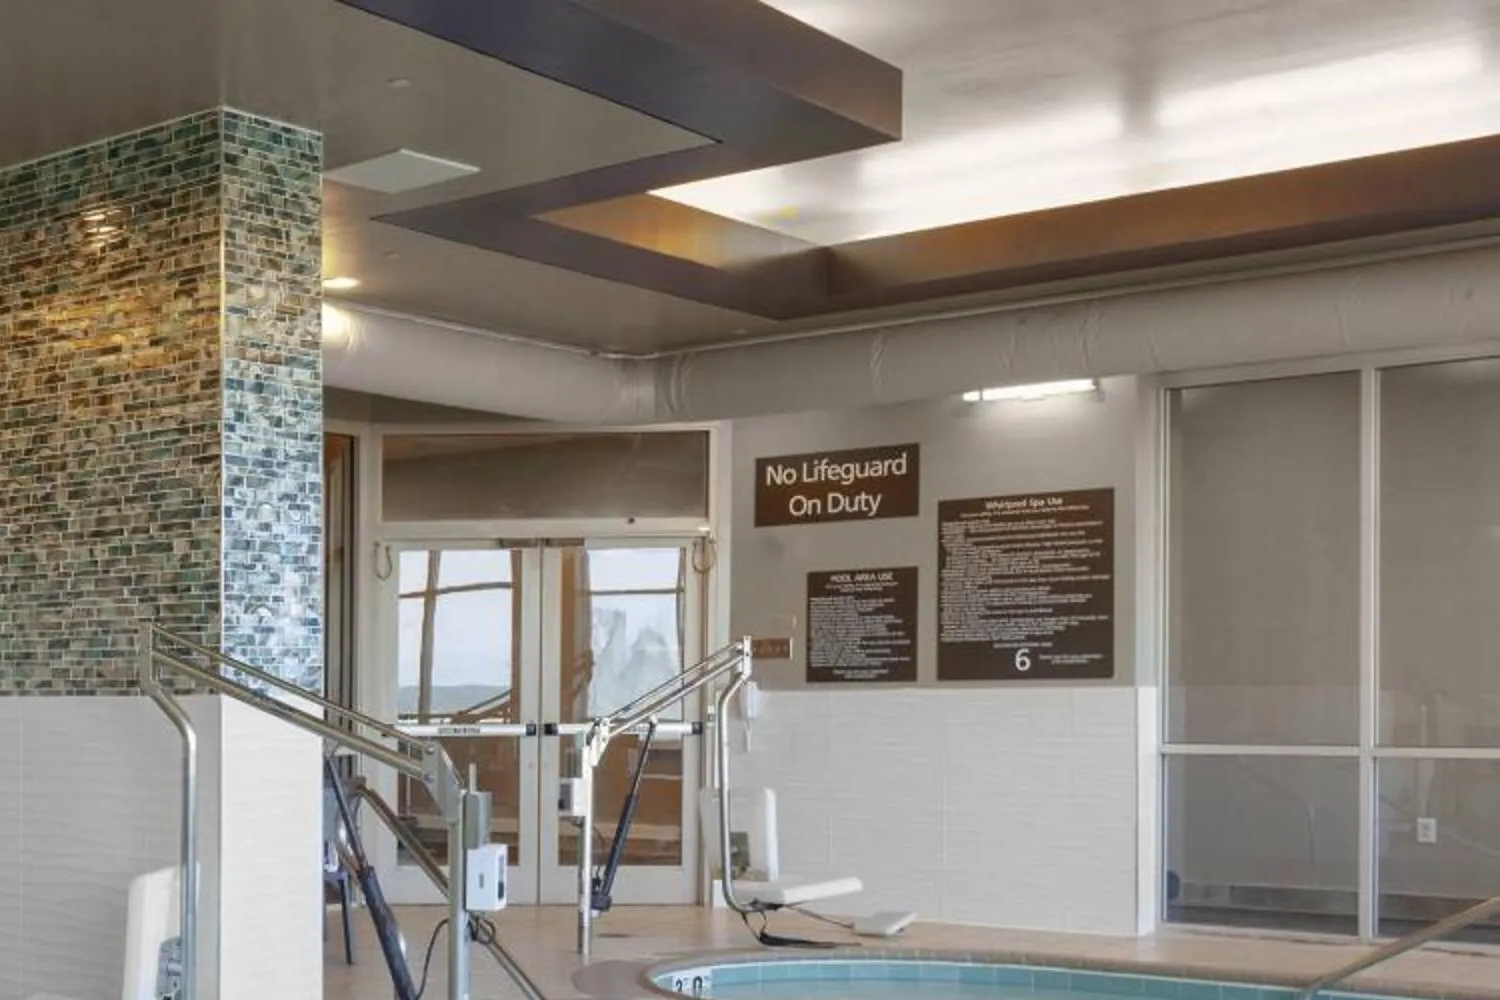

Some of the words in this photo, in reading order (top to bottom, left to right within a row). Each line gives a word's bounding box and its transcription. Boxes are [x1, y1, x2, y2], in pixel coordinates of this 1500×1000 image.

[765, 464, 797, 486] No
[803, 452, 907, 485] Lifeguard
[789, 495, 821, 516] On
[827, 491, 882, 516] Duty
[1015, 648, 1031, 671] 6
